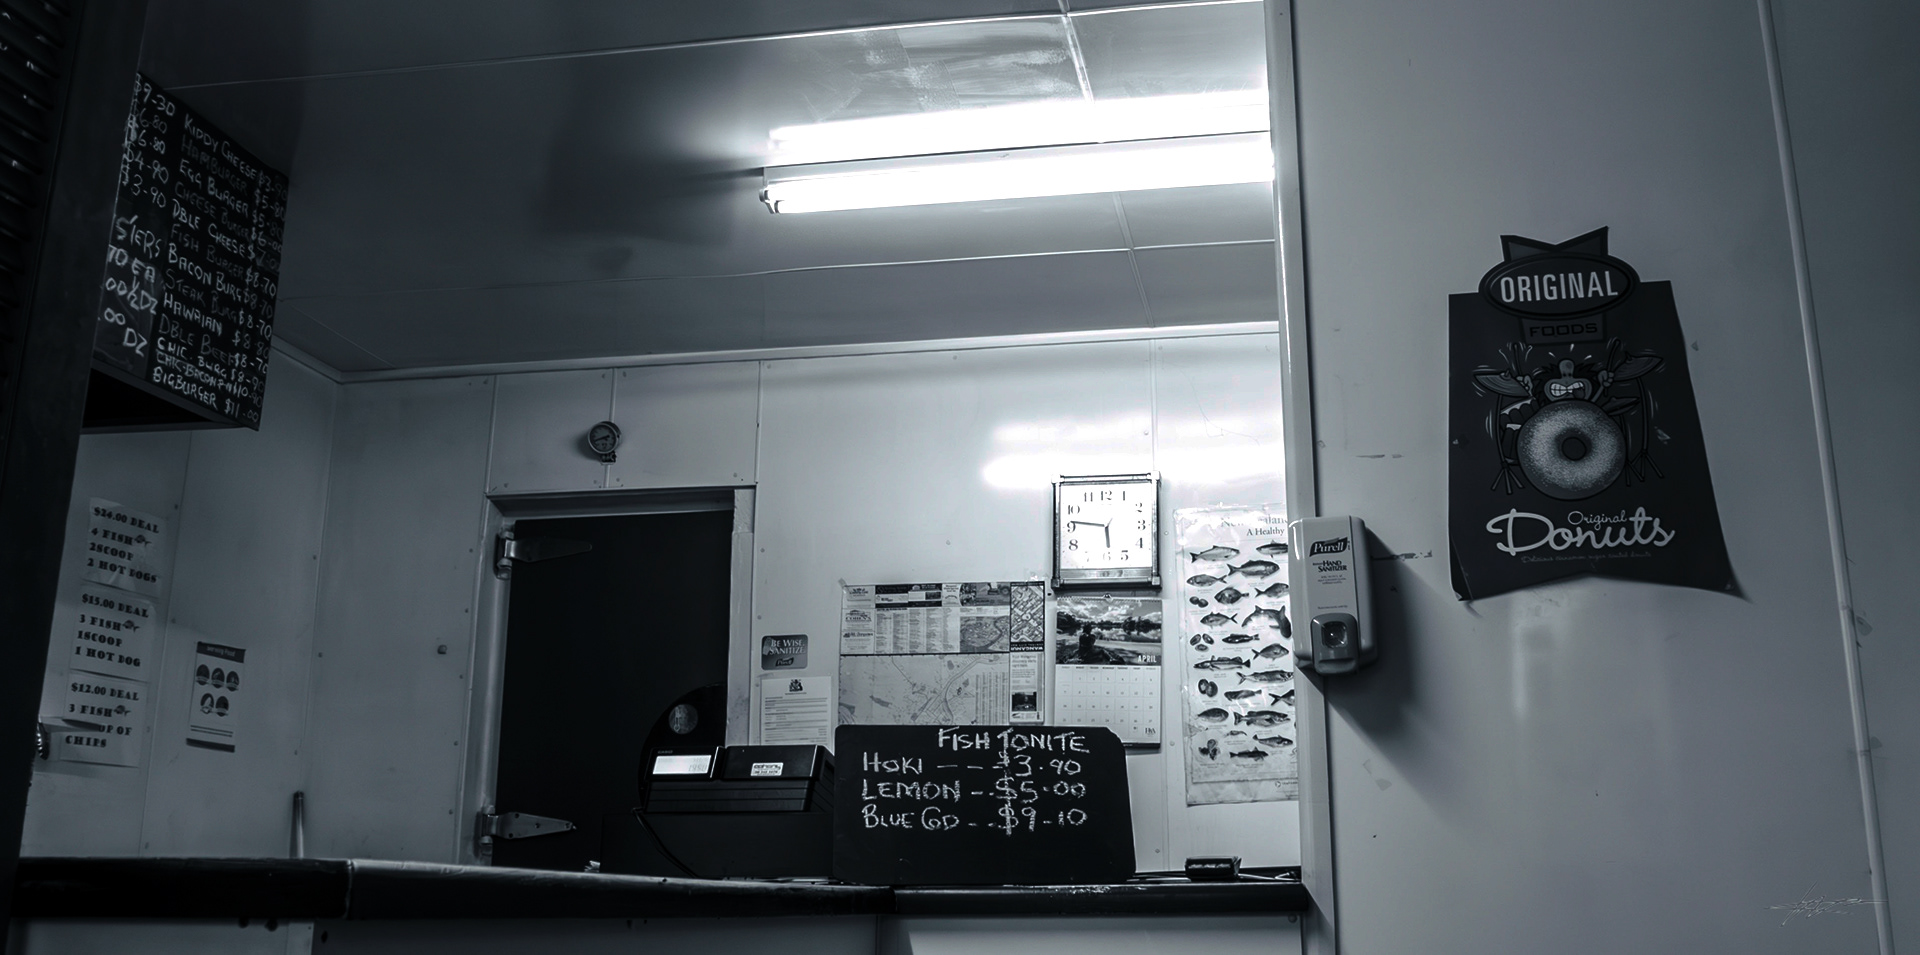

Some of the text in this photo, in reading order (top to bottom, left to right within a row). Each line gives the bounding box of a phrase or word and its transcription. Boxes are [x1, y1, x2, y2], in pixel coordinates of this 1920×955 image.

[184, 113, 219, 153] KIDDY
[220, 141, 257, 181] CHEESE
[181, 133, 248, 196] HAMBURGER
[207, 176, 248, 218] BURGER
[175, 181, 217, 219] CHEESE
[221, 206, 250, 241] BURGER
[172, 198, 201, 231] DBLE
[208, 223, 245, 259] CHEESE
[171, 223, 199, 253] FISH
[206, 244, 244, 281] BURGER
[168, 242, 212, 286] BACON
[165, 267, 206, 308] STEAK
[1500, 270, 1618, 303] ORIGINAL
[158, 313, 195, 347] DBLE
[1530, 322, 1598, 337] FOODS
[197, 355, 228, 381] BURG
[1084, 491, 1093, 502] 11
[1101, 490, 1112, 501] 12
[1068, 504, 1080, 515] 10
[1135, 502, 1143, 513] 2
[94, 506, 159, 534] $24.00 DEAL
[1066, 521, 1076, 533] 9
[1137, 519, 1146, 530] 3
[1486, 506, 1676, 556] Donuts
[1567, 509, 1628, 531] Original
[91, 527, 133, 546] 4 FISH
[1246, 526, 1285, 537] A Healthy
[1068, 539, 1079, 551] 8
[1135, 537, 1143, 549] 4
[1313, 541, 1344, 553] Purell
[1120, 549, 1129, 561] 5
[87, 558, 158, 584] 2 HOT DOGS
[82, 593, 149, 618] $15.00 DEAL
[79, 614, 122, 632] 3 FISH
[771, 639, 781, 648] BE
[75, 646, 141, 668] 1 HOT DOG
[1137, 655, 1157, 663] APRIL
[71, 682, 140, 701] $12.00 DEAL
[69, 703, 113, 718] 3 FISH
[65, 735, 107, 749] CHIPS
[116, 726, 133, 737] OF
[938, 726, 1090, 755] FISH TONITE
[863, 752, 922, 776] HOKI
[861, 779, 960, 803] LEMON
[861, 803, 914, 828] BLUE
